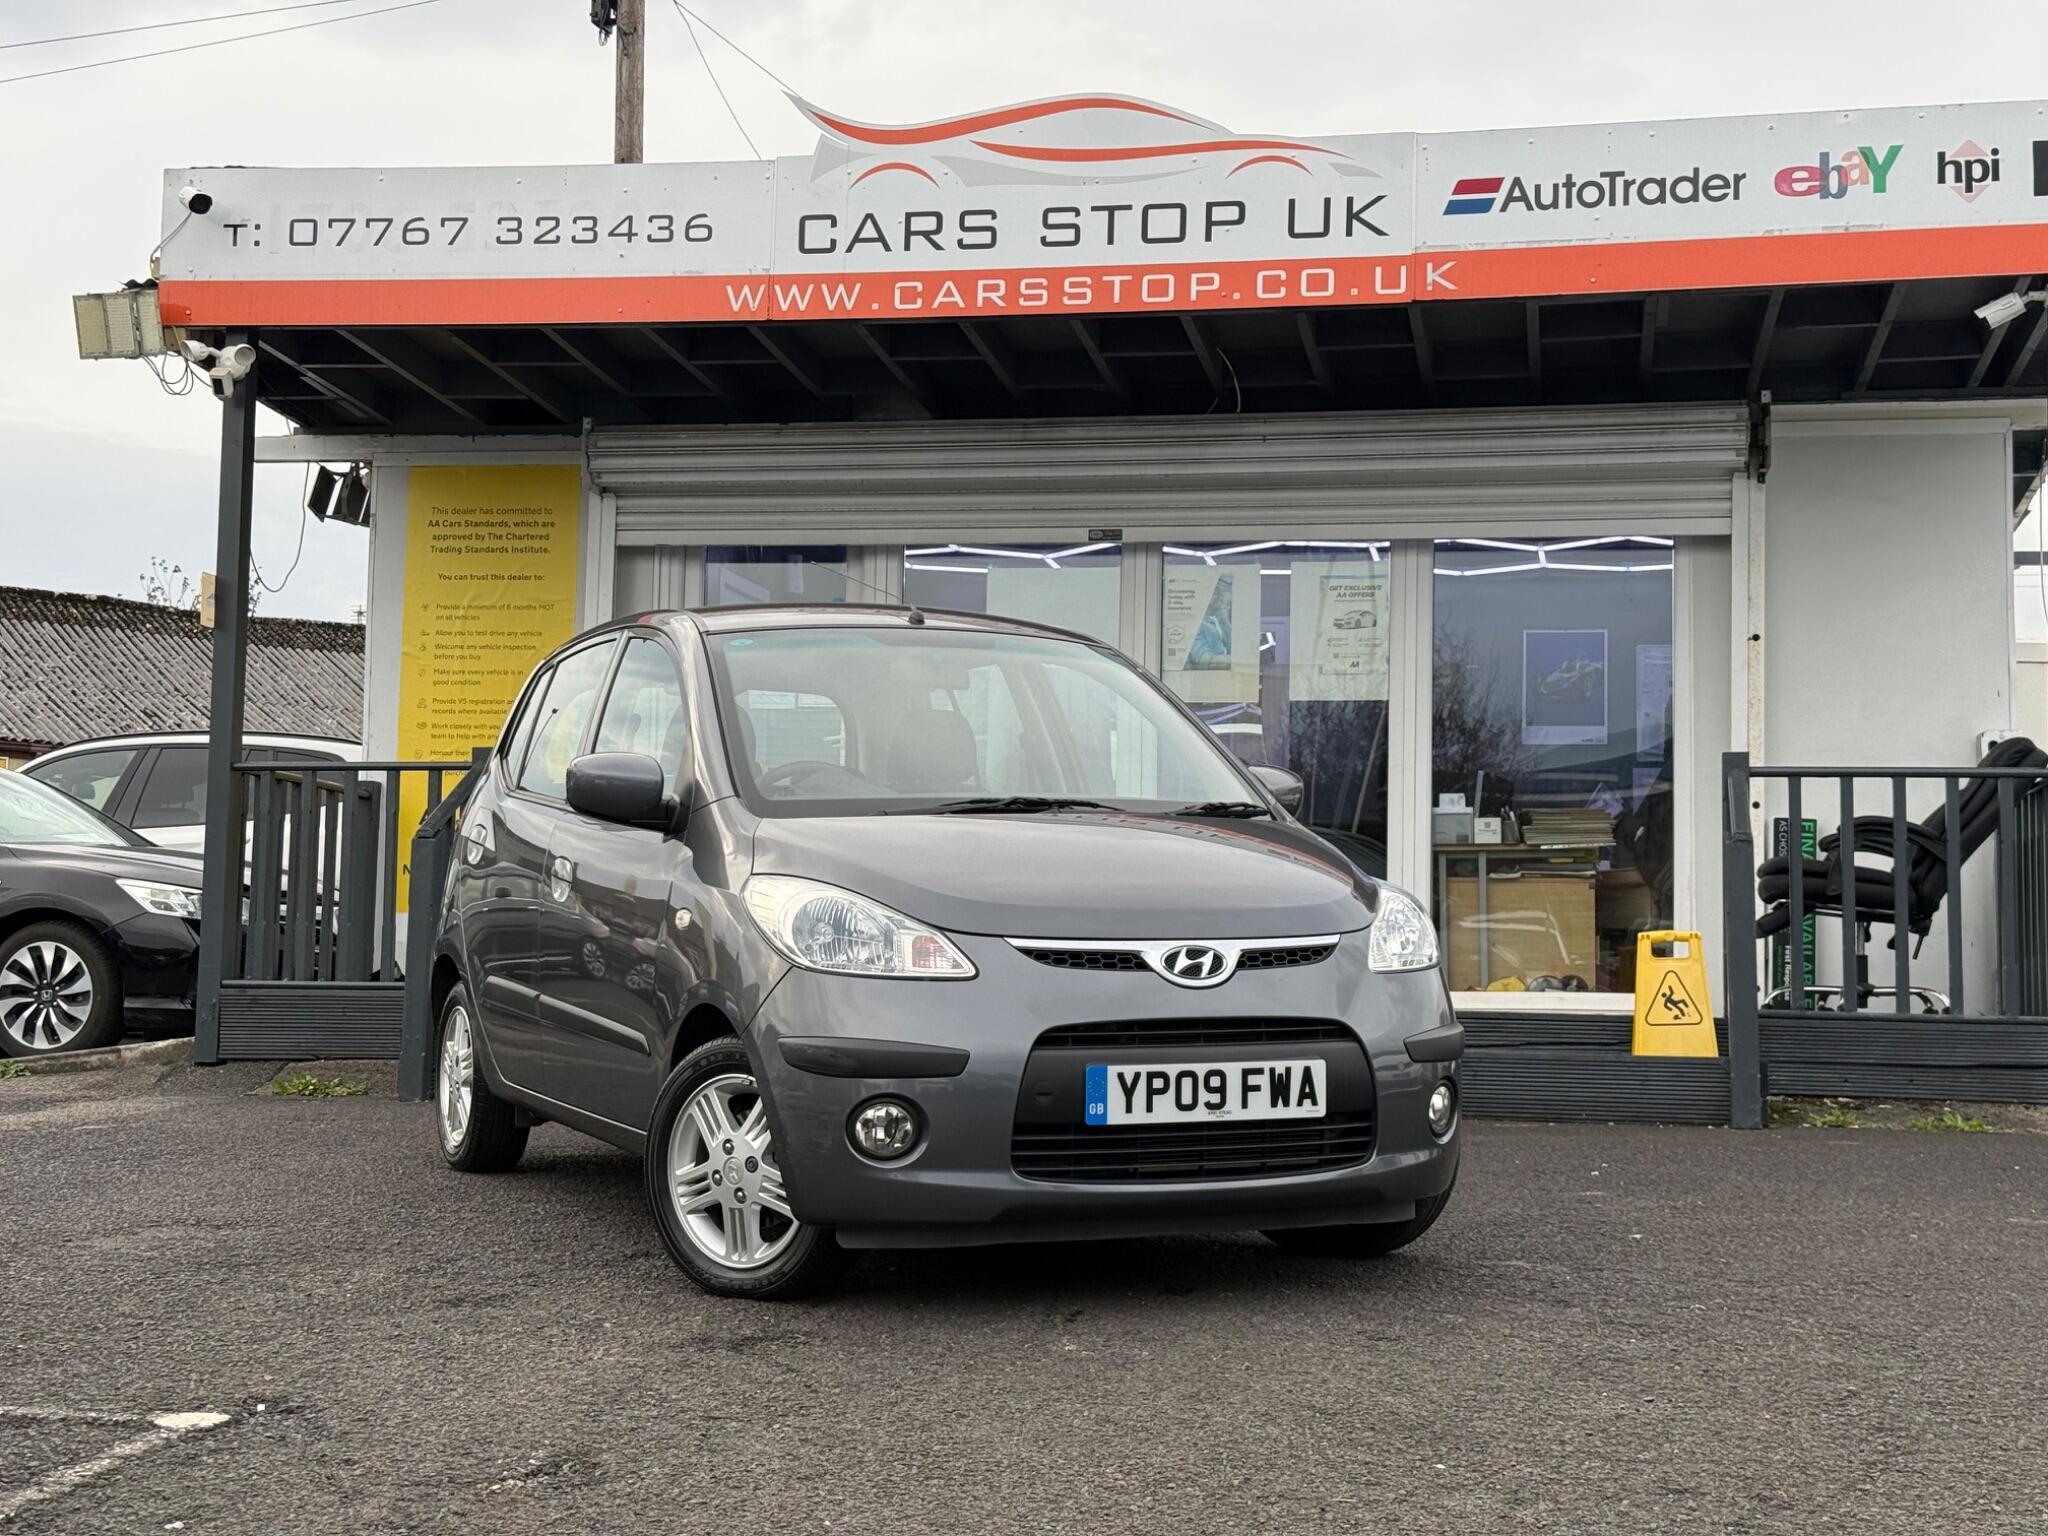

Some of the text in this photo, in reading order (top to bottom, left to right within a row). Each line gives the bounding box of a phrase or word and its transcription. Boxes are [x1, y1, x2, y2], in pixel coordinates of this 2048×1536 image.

[1936, 147, 2000, 193] hpi
[1500, 167, 1746, 213] AutoTrader
[223, 213, 714, 247] T: 07767 323436
[798, 196, 1389, 255] CARS STOP UK
[726, 260, 1458, 312] WWW.CARSSTOP.CO.UK
[432, 507, 553, 515] This dealer has committed to
[427, 520, 440, 528] AA
[442, 520, 461, 528] Cars
[464, 520, 511, 528] Standards,
[513, 520, 539, 528] which
[432, 533, 473, 541] approved
[475, 533, 485, 541] by
[430, 545, 551, 554] Trading Standards Institute.
[491, 573, 505, 581] this
[507, 573, 532, 581] dealer
[468, 698, 506, 706] registration
[1779, 820, 1788, 857] AS CHOS
[1117, 1066, 1319, 1113] YP09 FWA
[1089, 1103, 1104, 1115] GB
